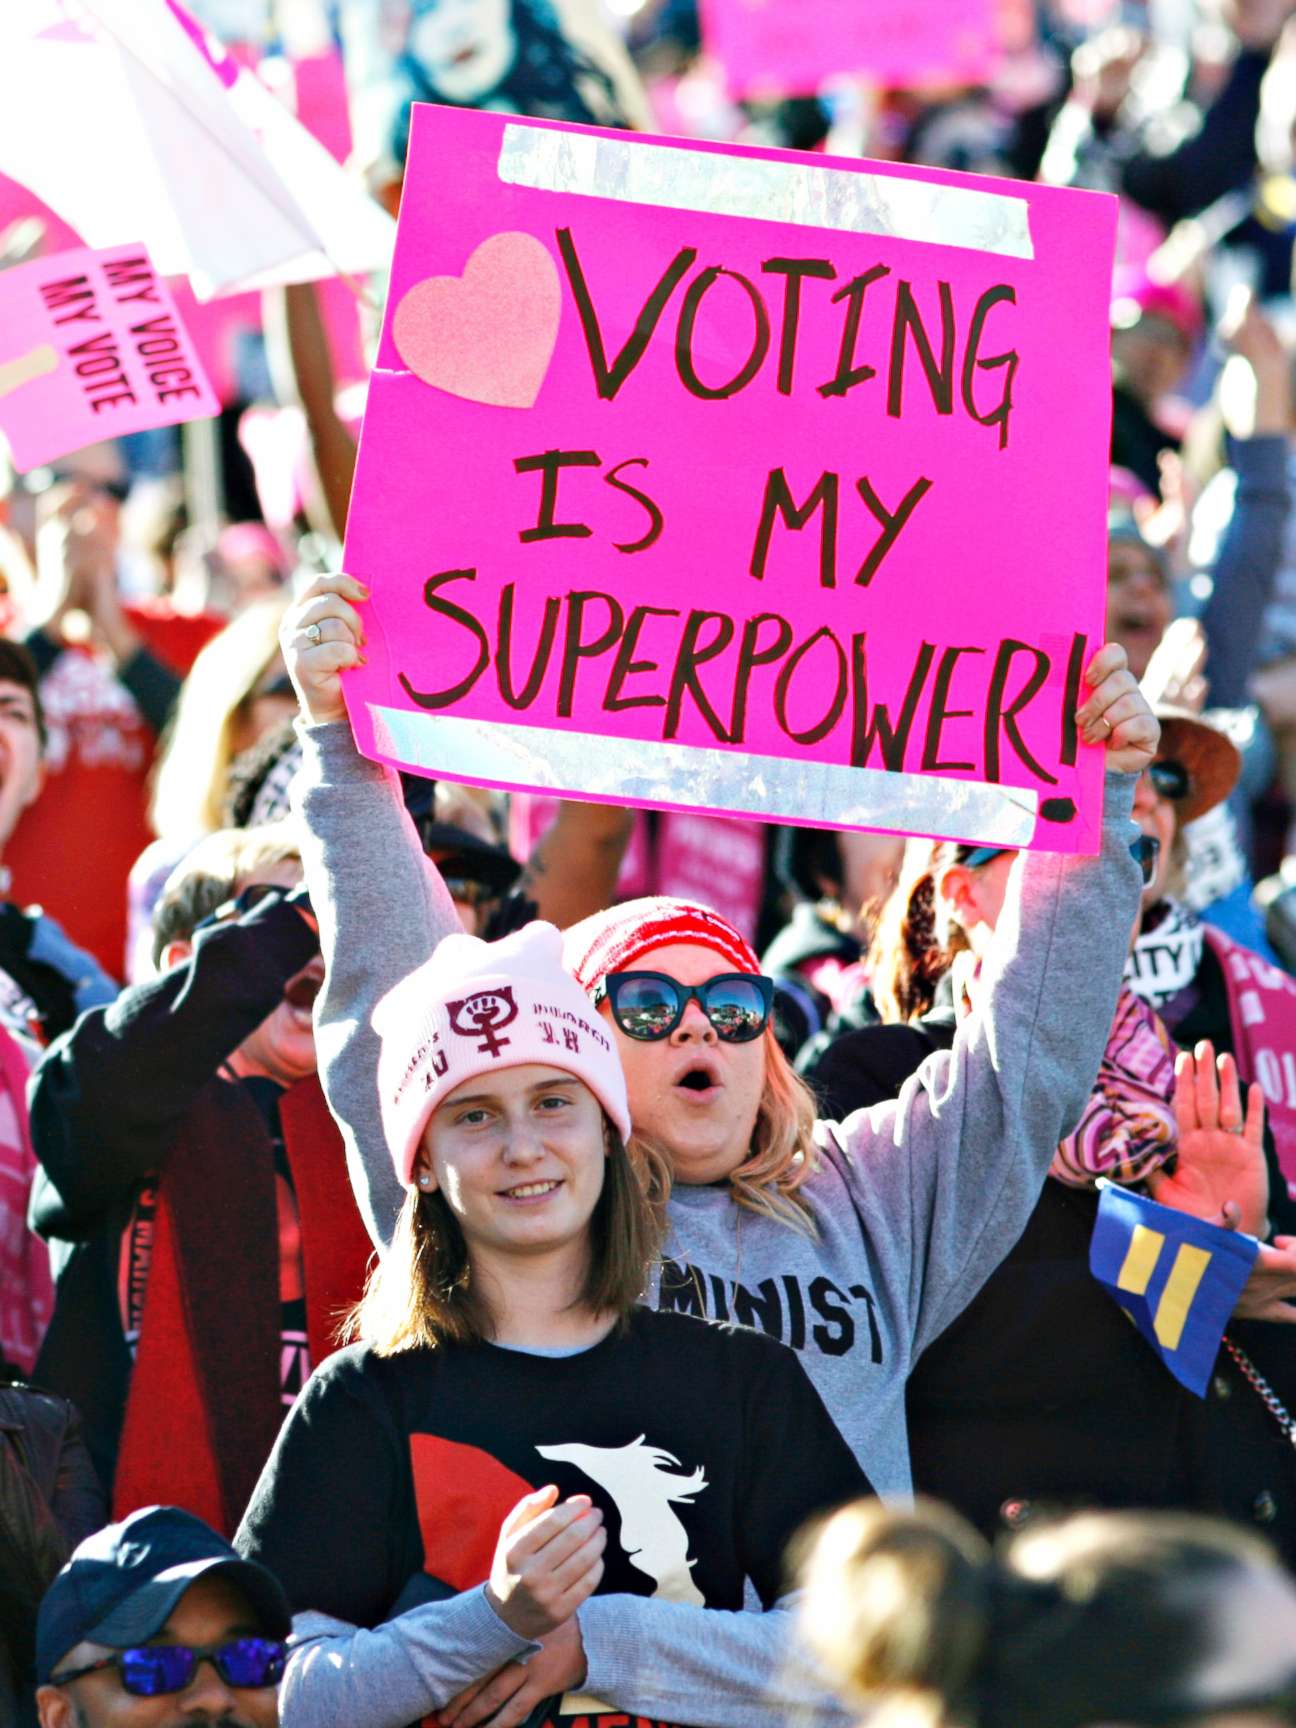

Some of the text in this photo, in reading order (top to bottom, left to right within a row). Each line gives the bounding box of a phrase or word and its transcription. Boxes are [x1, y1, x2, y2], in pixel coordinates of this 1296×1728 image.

[40, 275, 138, 414] MY VOTE
[100, 256, 201, 405] MY VOICE
[554, 227, 1019, 450] VOTING
[514, 449, 934, 589] IS MY
[398, 567, 1088, 823] SUPERPOWER!
